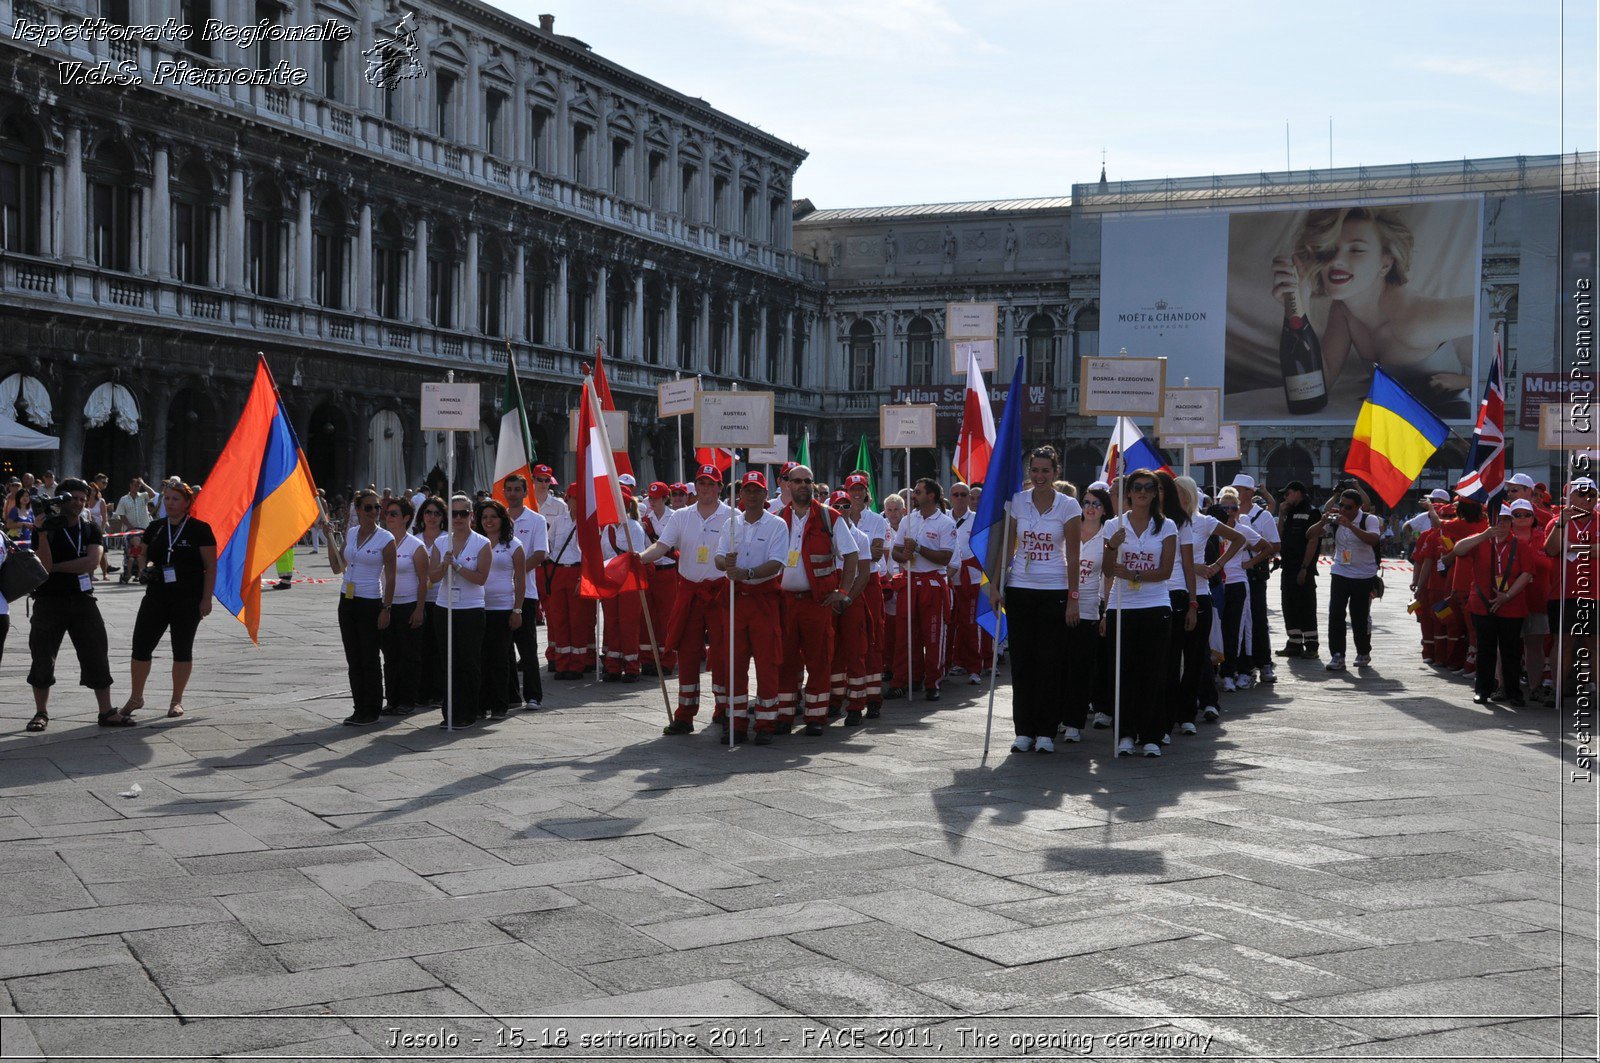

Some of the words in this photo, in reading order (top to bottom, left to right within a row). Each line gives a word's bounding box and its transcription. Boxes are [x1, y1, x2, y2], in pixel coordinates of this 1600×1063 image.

[1148, 314, 1154, 322] &
[1156, 312, 1207, 322] CHANDON
[1525, 377, 1595, 393] Museo
[894, 388, 939, 402] Julian
[1023, 530, 1053, 542] FACE
[1021, 540, 1054, 552] TEAM
[1125, 551, 1154, 561] FACE
[1123, 560, 1155, 570] TEAM
